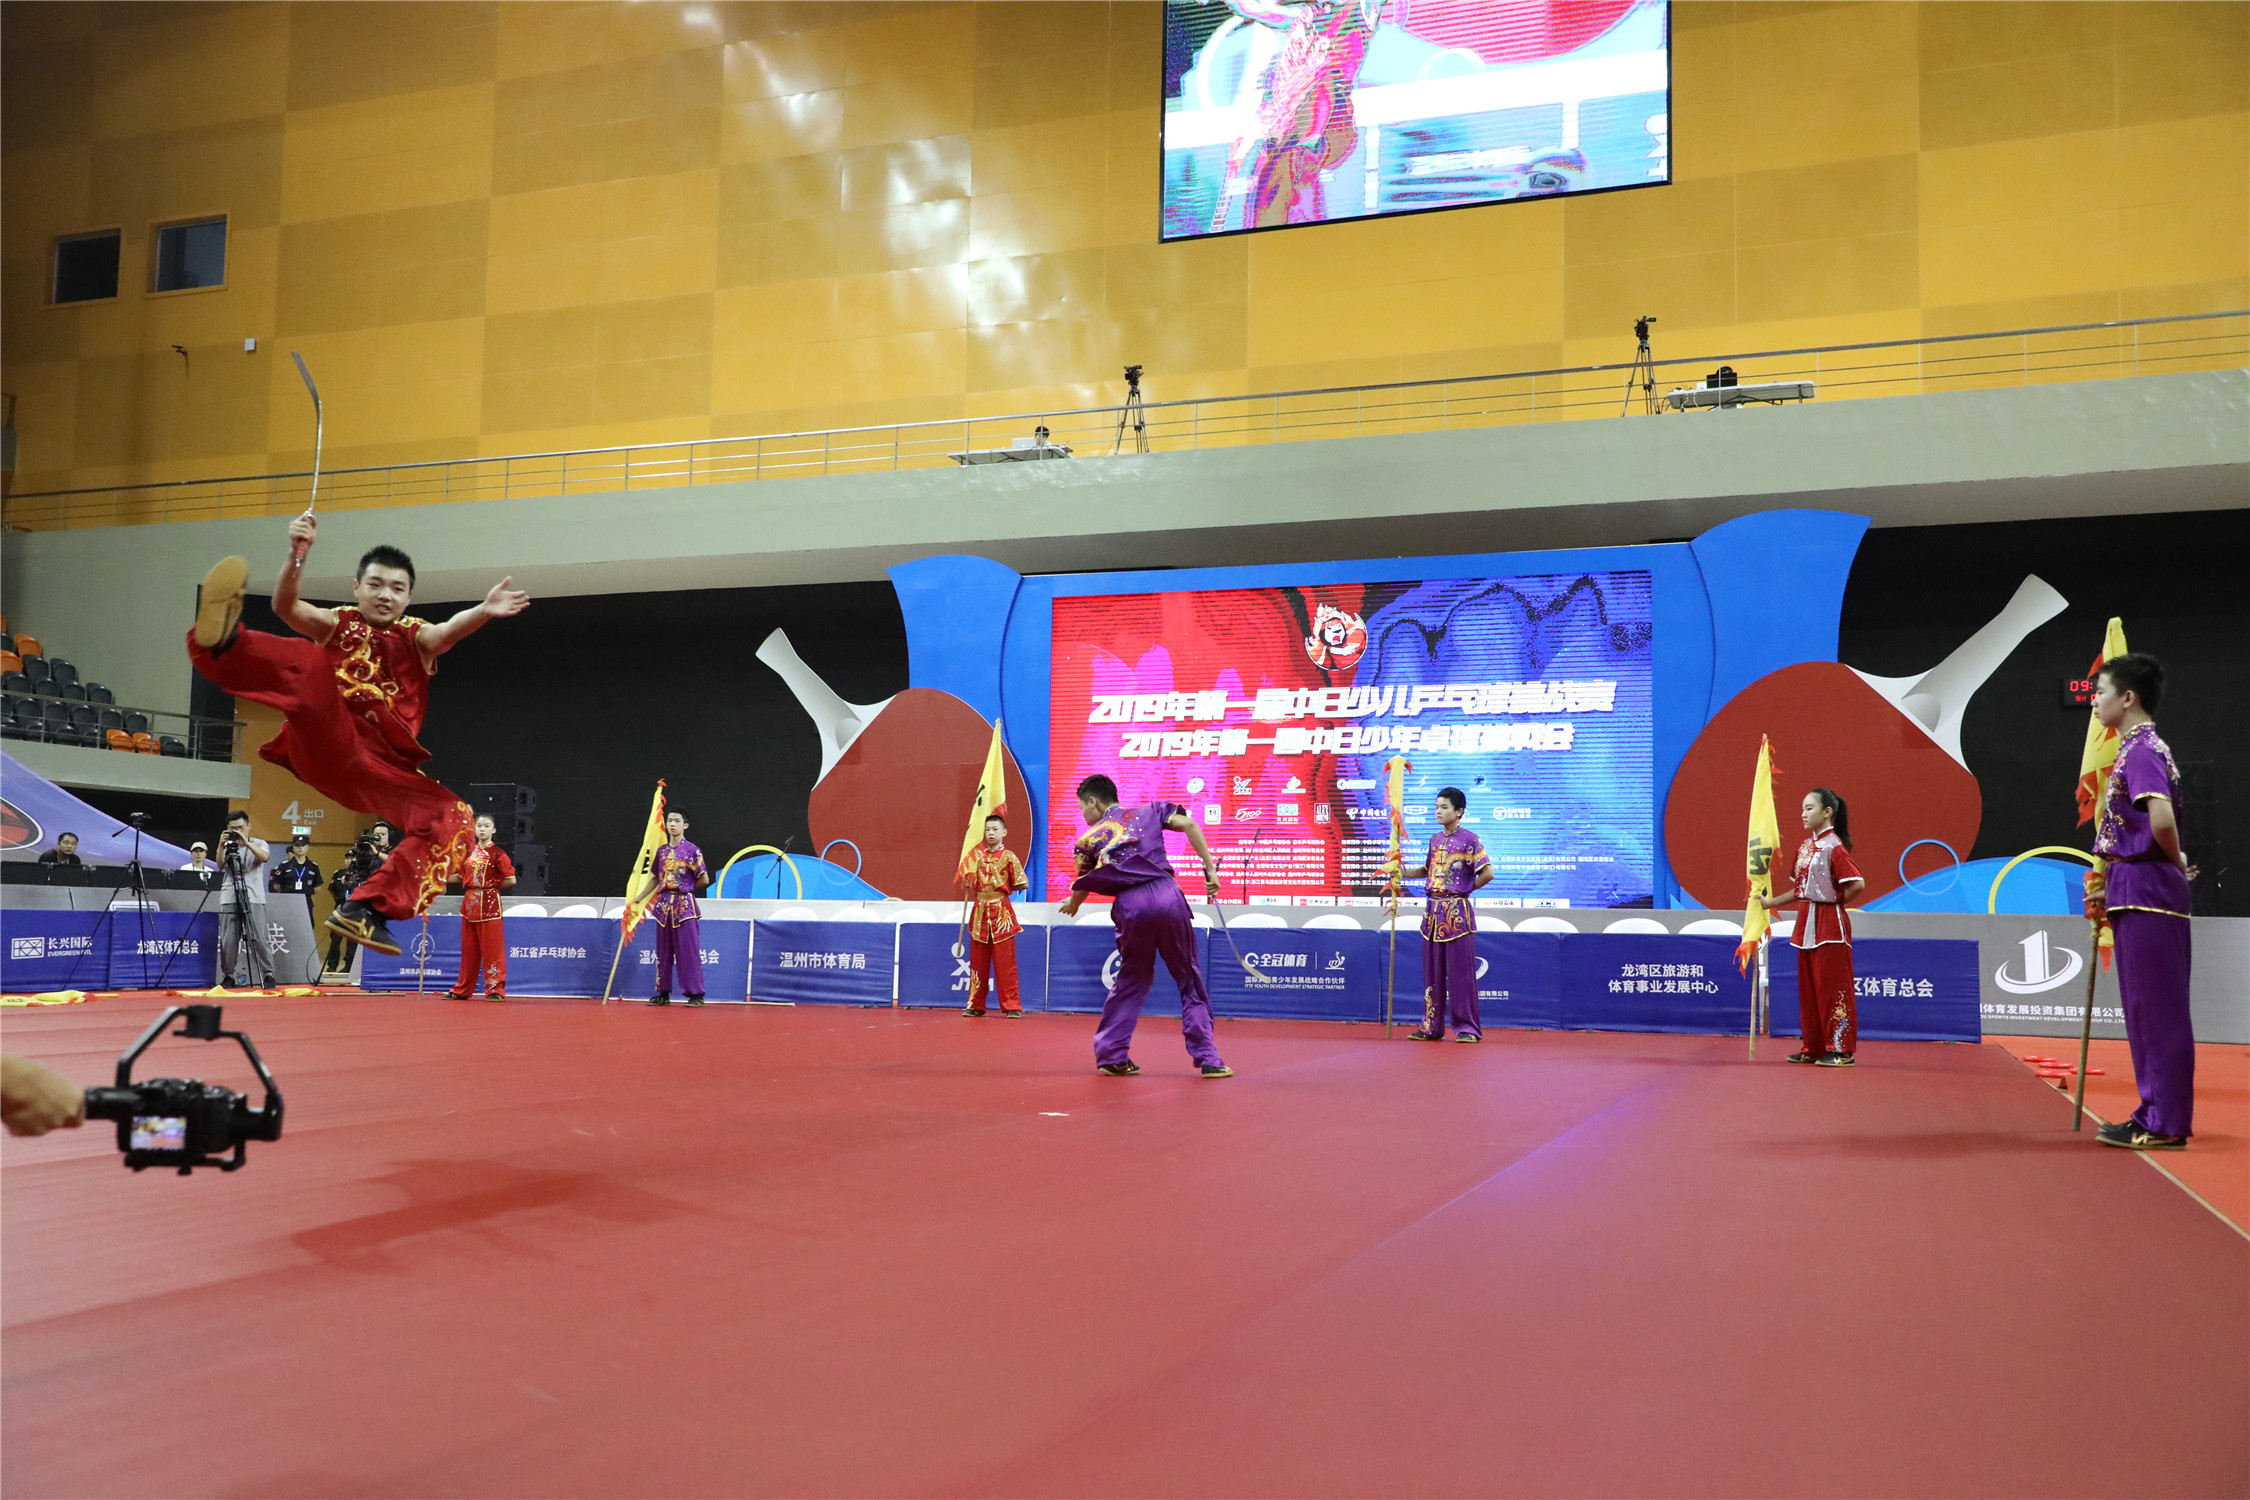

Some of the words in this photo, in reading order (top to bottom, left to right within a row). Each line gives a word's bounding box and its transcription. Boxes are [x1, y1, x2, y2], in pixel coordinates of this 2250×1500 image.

[281, 800, 301, 825] 4
[303, 809, 325, 819] 出口
[47, 936, 93, 950] 长兴国际
[137, 939, 199, 955] 龙湾区体育总会
[509, 946, 587, 959] 浙江省乒乓球协会
[779, 952, 866, 970] 温州市体育局
[1259, 953, 1309, 968] 全冠体育
[1621, 963, 1704, 978] 龙湾区旅游和
[1244, 976, 1346, 985] 国际青少年发展战略合作伙伴
[1608, 980, 1719, 994] 体育事业发展中心
